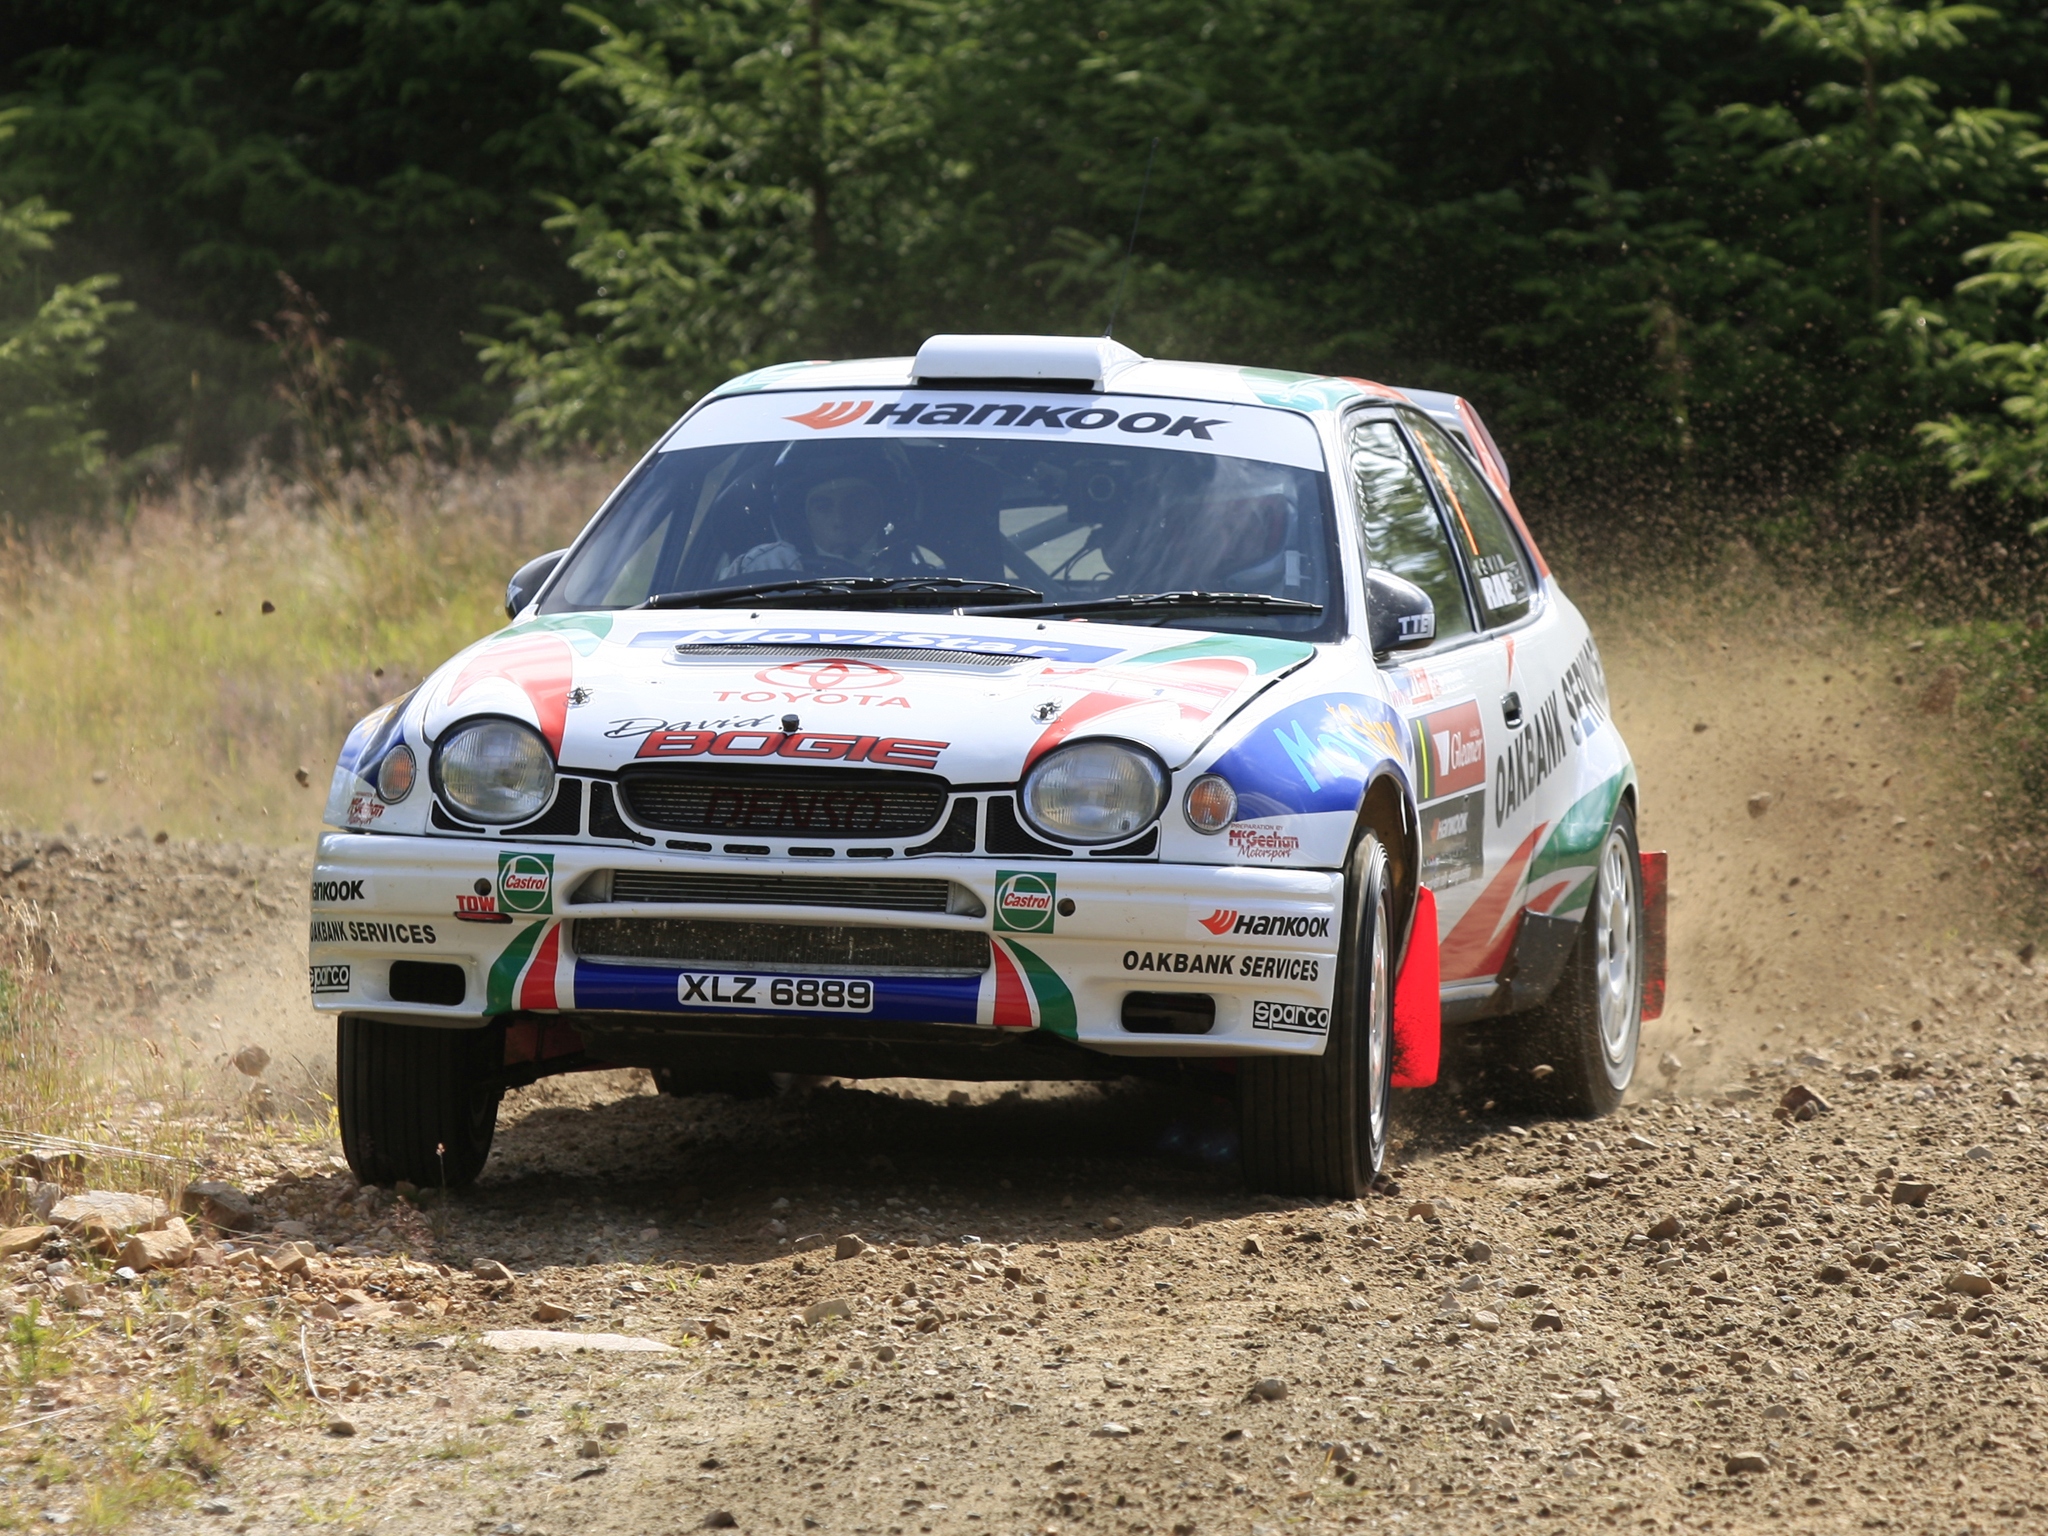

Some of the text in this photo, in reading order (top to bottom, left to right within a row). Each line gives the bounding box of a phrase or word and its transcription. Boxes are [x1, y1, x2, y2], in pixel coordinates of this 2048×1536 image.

[713, 690, 912, 709] TOYOTA
[603, 714, 776, 737] David
[634, 730, 951, 769] BOGIE
[1496, 689, 1567, 828] OAKBANK
[704, 792, 883, 831] DENSO
[1229, 830, 1299, 849] McGeehan
[1237, 845, 1292, 862] Motorsport
[505, 874, 548, 891] Castrol
[456, 895, 495, 912] TOW
[1004, 892, 1051, 909] Castrol
[348, 921, 437, 944] SERVICES
[1122, 950, 1319, 982] OAKBANK SERVICES
[681, 974, 871, 1009] XLZ 6889
[1254, 1002, 1329, 1030] sparco
